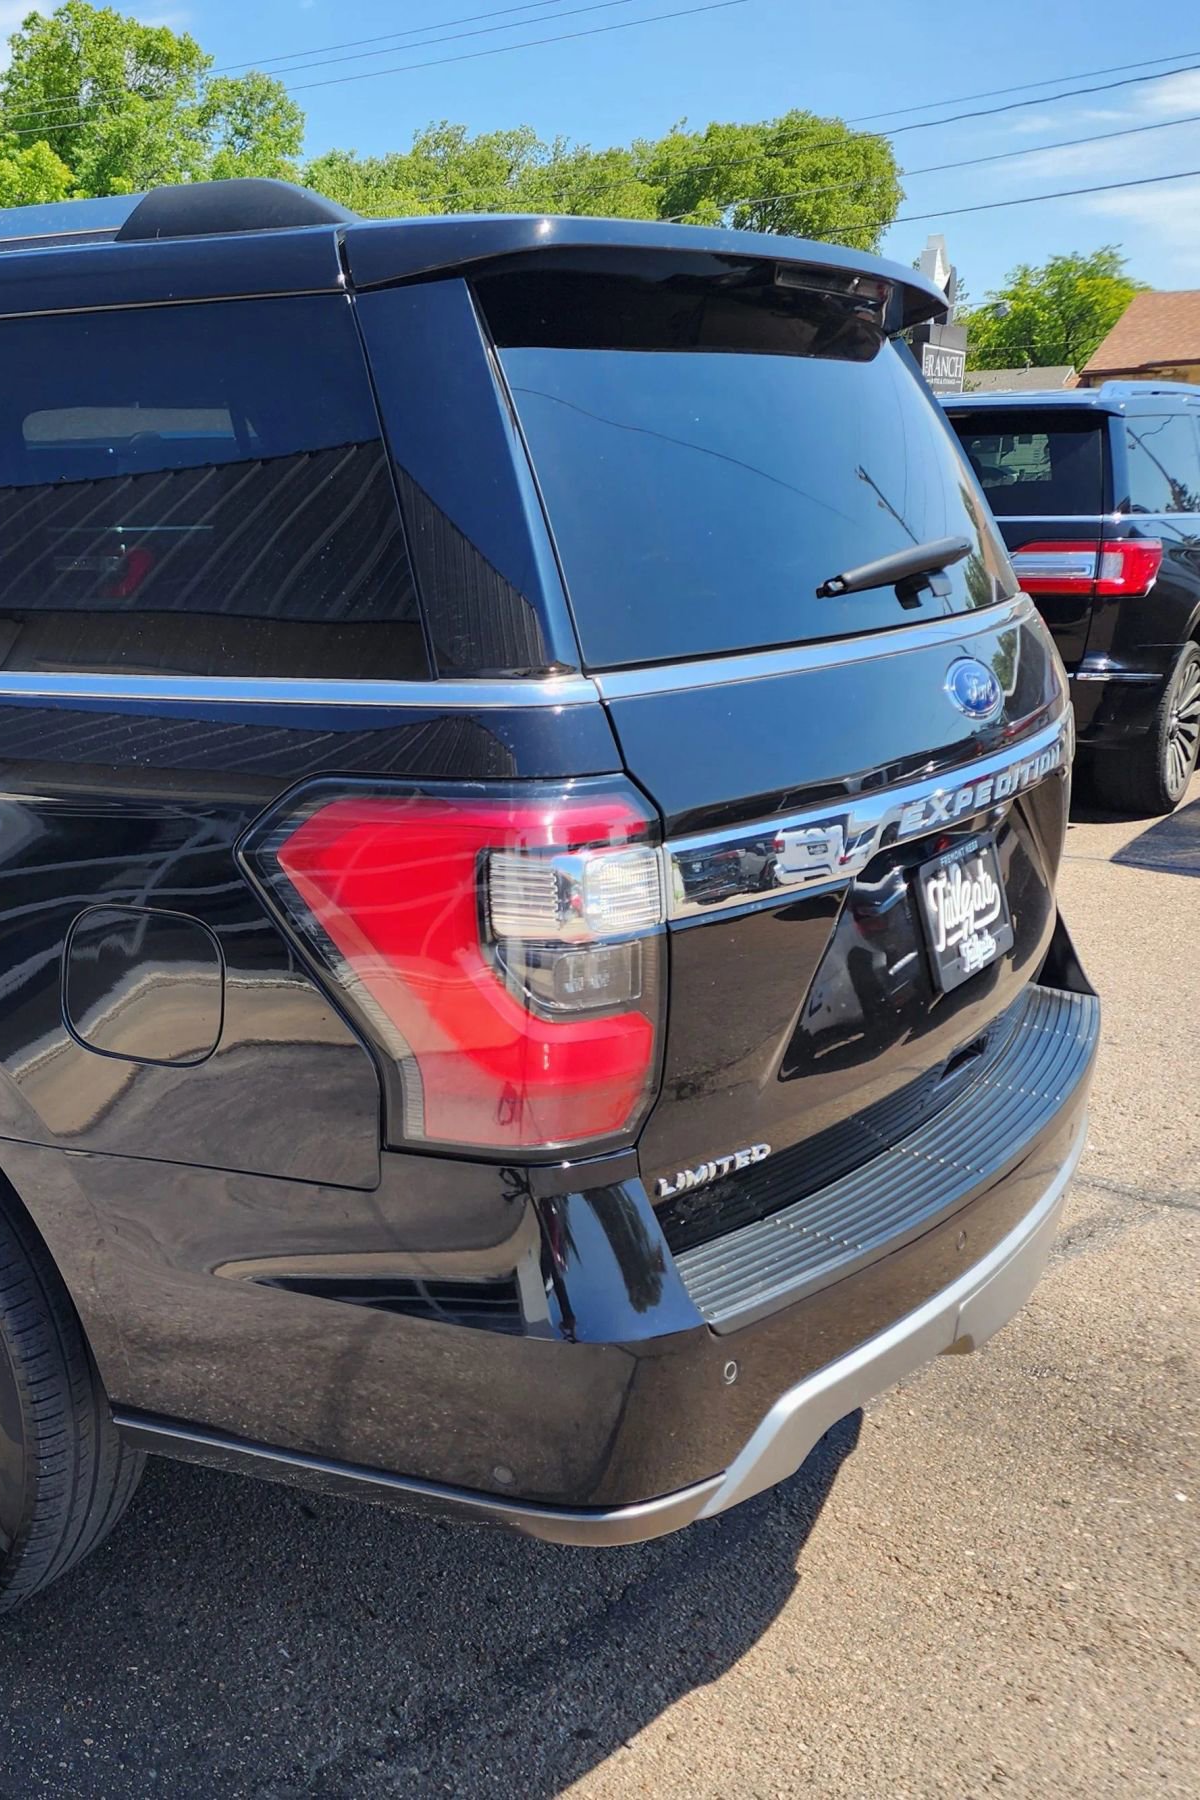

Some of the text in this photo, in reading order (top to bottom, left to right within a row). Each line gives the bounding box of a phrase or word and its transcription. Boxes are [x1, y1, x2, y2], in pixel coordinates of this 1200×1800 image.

[927, 354, 963, 377] RANCH
[963, 670, 997, 706] Ford
[898, 744, 1060, 836] EXPEDITION
[927, 858, 1001, 952] Tailgate
[656, 1143, 772, 1197] LIMITED
